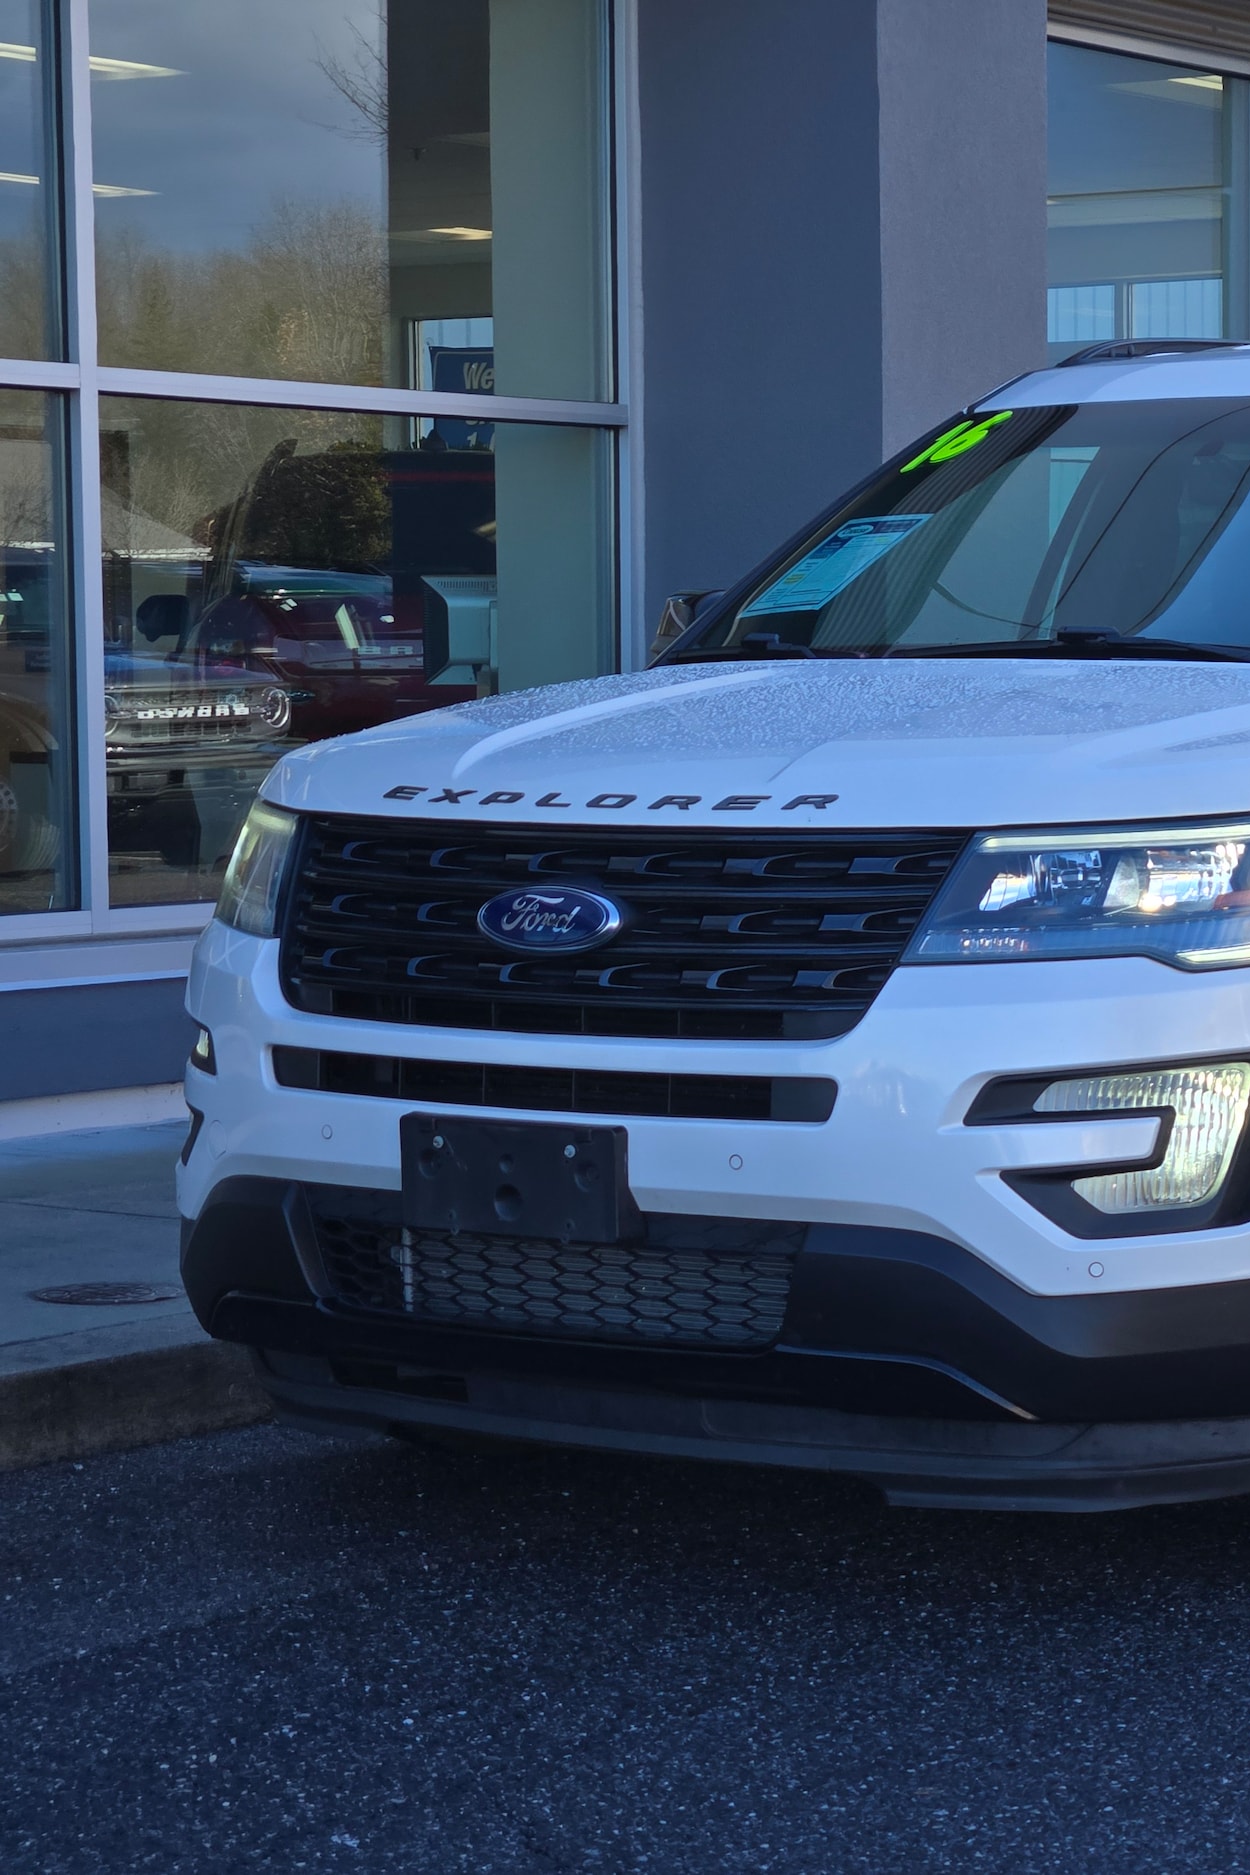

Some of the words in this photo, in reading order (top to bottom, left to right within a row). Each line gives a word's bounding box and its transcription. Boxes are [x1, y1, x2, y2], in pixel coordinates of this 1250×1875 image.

[900, 410, 1013, 473] 16
[382, 785, 840, 811] EXPLORER
[501, 894, 581, 933] Ford
